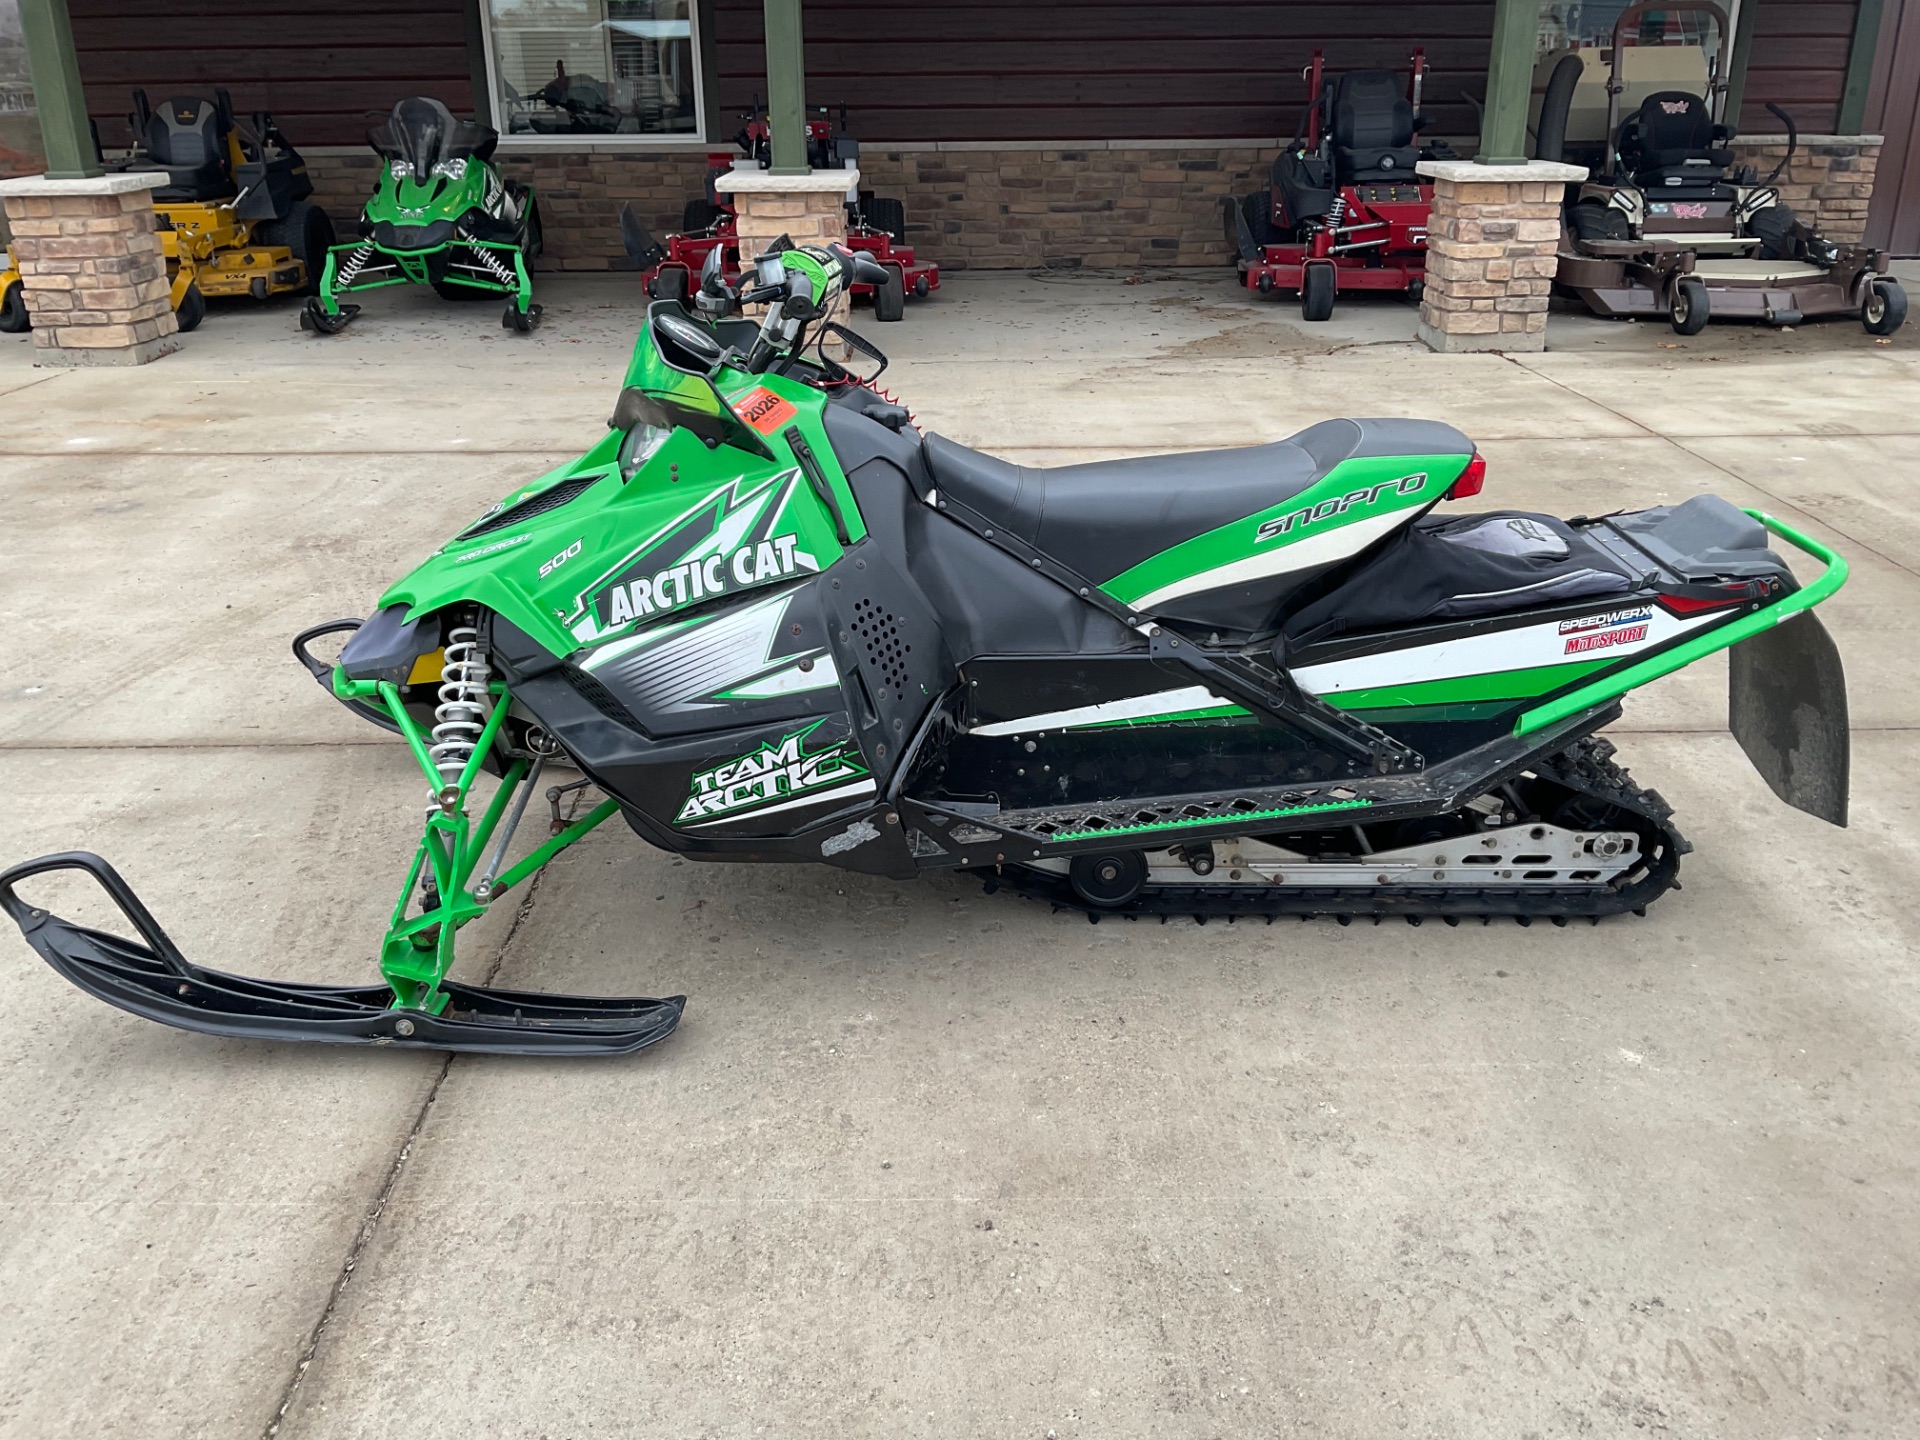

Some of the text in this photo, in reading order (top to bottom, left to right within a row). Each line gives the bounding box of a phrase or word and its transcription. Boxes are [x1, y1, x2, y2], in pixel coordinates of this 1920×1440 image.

[744, 395, 780, 422] 2026
[539, 536, 584, 580] 500
[610, 532, 798, 626] ARCTIC CAT
[1559, 605, 1653, 632] SPEEDWERX
[677, 749, 857, 821] ARCTIC
[694, 735, 801, 794] TEAM
